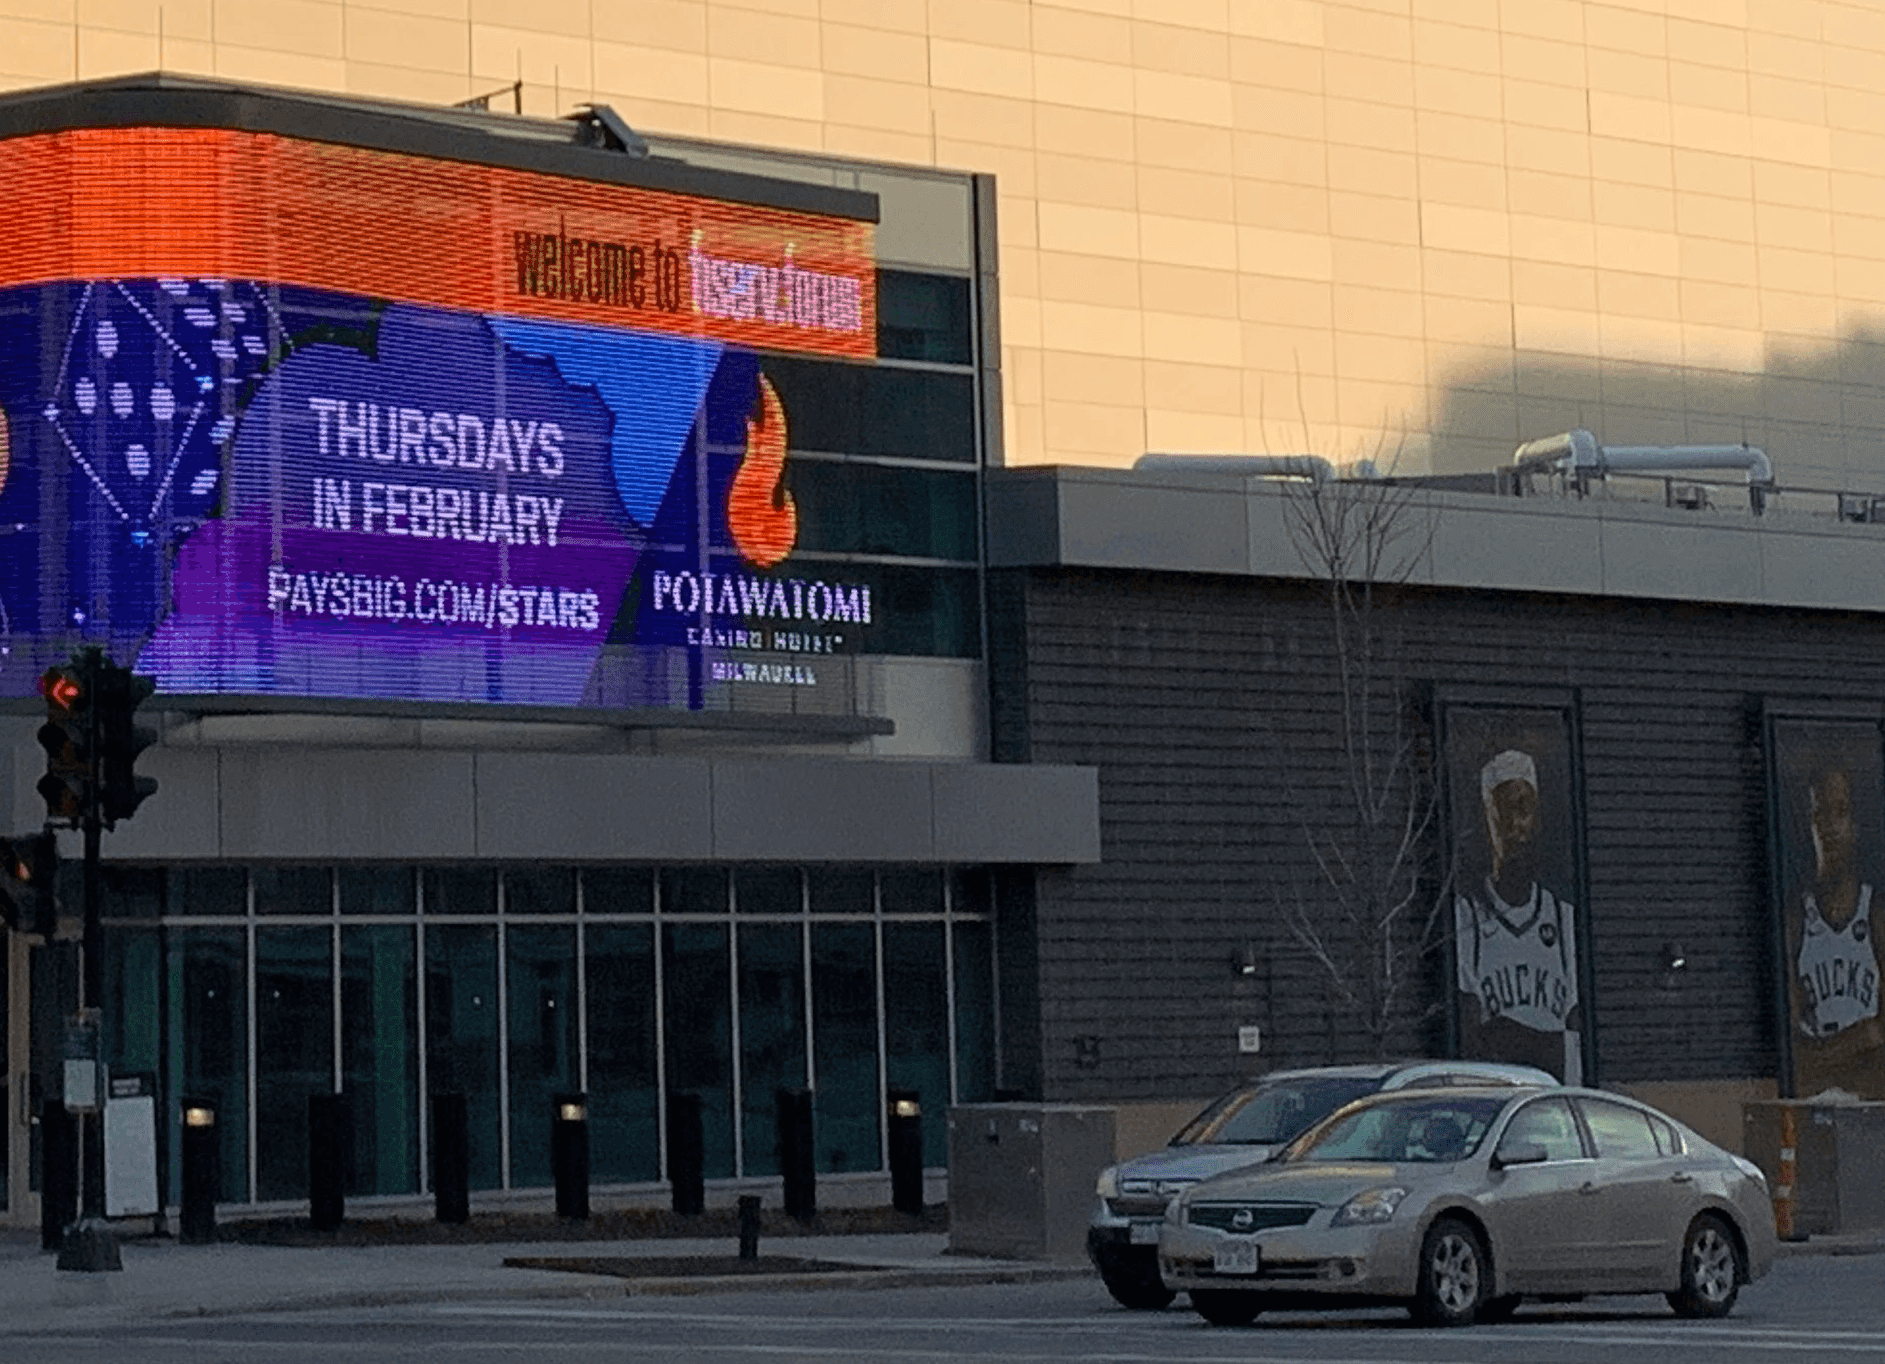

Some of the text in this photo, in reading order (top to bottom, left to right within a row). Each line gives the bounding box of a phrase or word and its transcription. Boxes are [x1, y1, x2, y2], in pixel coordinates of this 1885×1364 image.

[515, 214, 645, 310] welcome
[655, 238, 680, 314] to
[309, 397, 565, 476] THURSDAYS
[313, 478, 564, 547] IN FEBRUARY
[268, 565, 600, 630] PAYSBIG.COM/STARS
[653, 570, 872, 624] POTAWATOMI
[1481, 963, 1566, 1019] BUCKS
